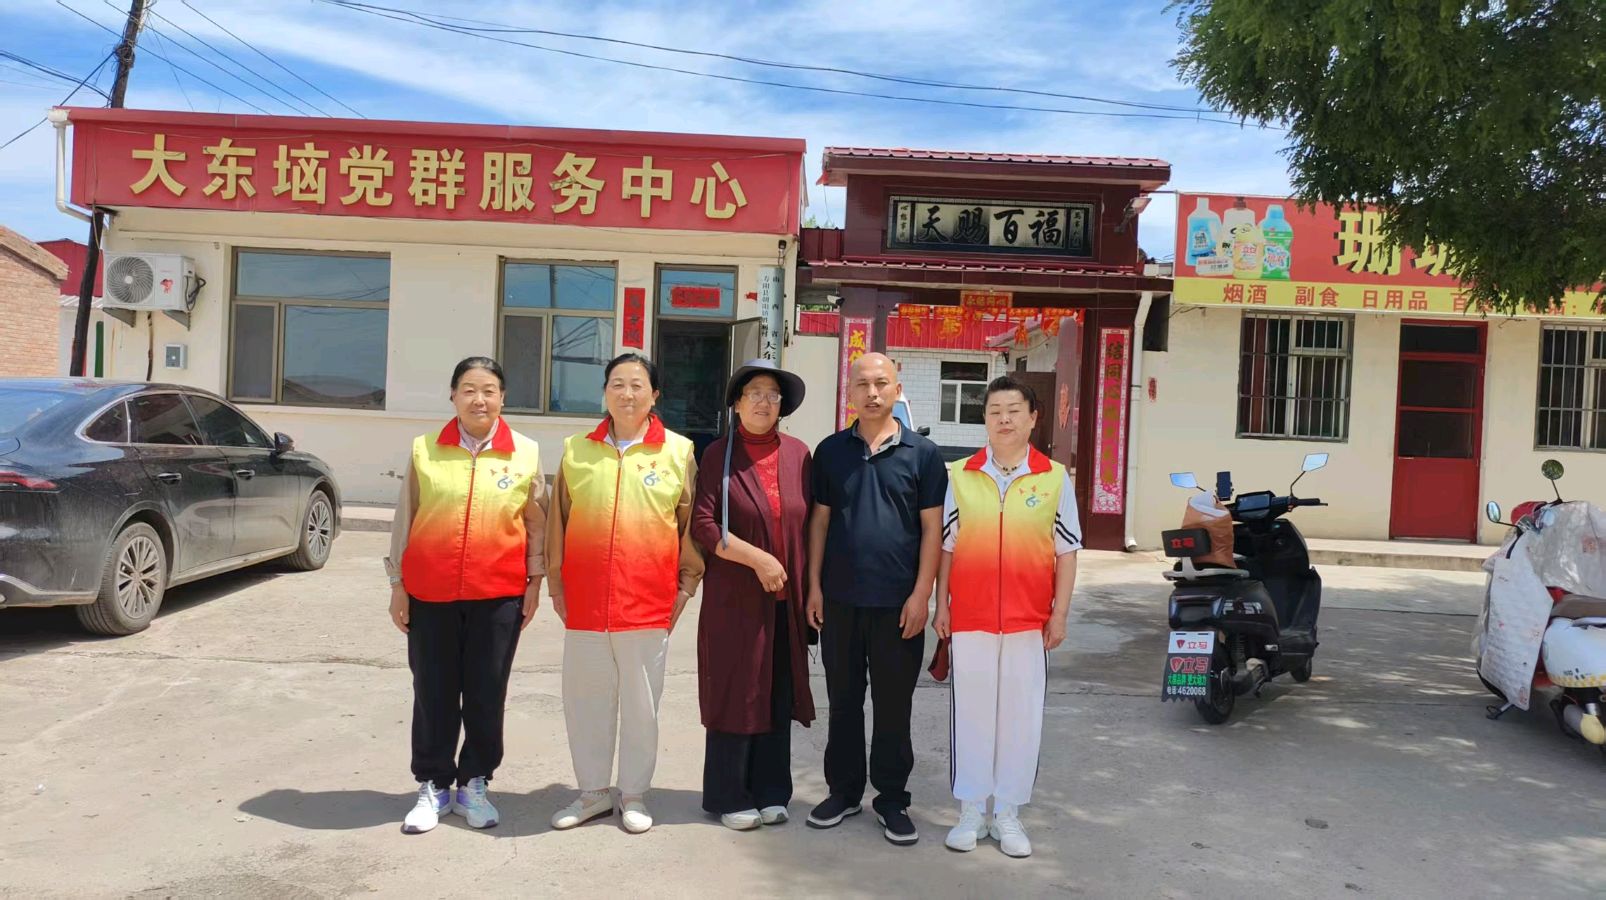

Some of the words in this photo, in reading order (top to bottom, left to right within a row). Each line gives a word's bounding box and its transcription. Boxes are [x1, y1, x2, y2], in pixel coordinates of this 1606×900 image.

[129, 133, 748, 219] 大东垴党群服务中心
[1223, 283, 1267, 304] 烟酒
[1295, 285, 1339, 308] 副食
[1362, 290, 1428, 311] 日用品
[1182, 656, 1208, 673] 立马
